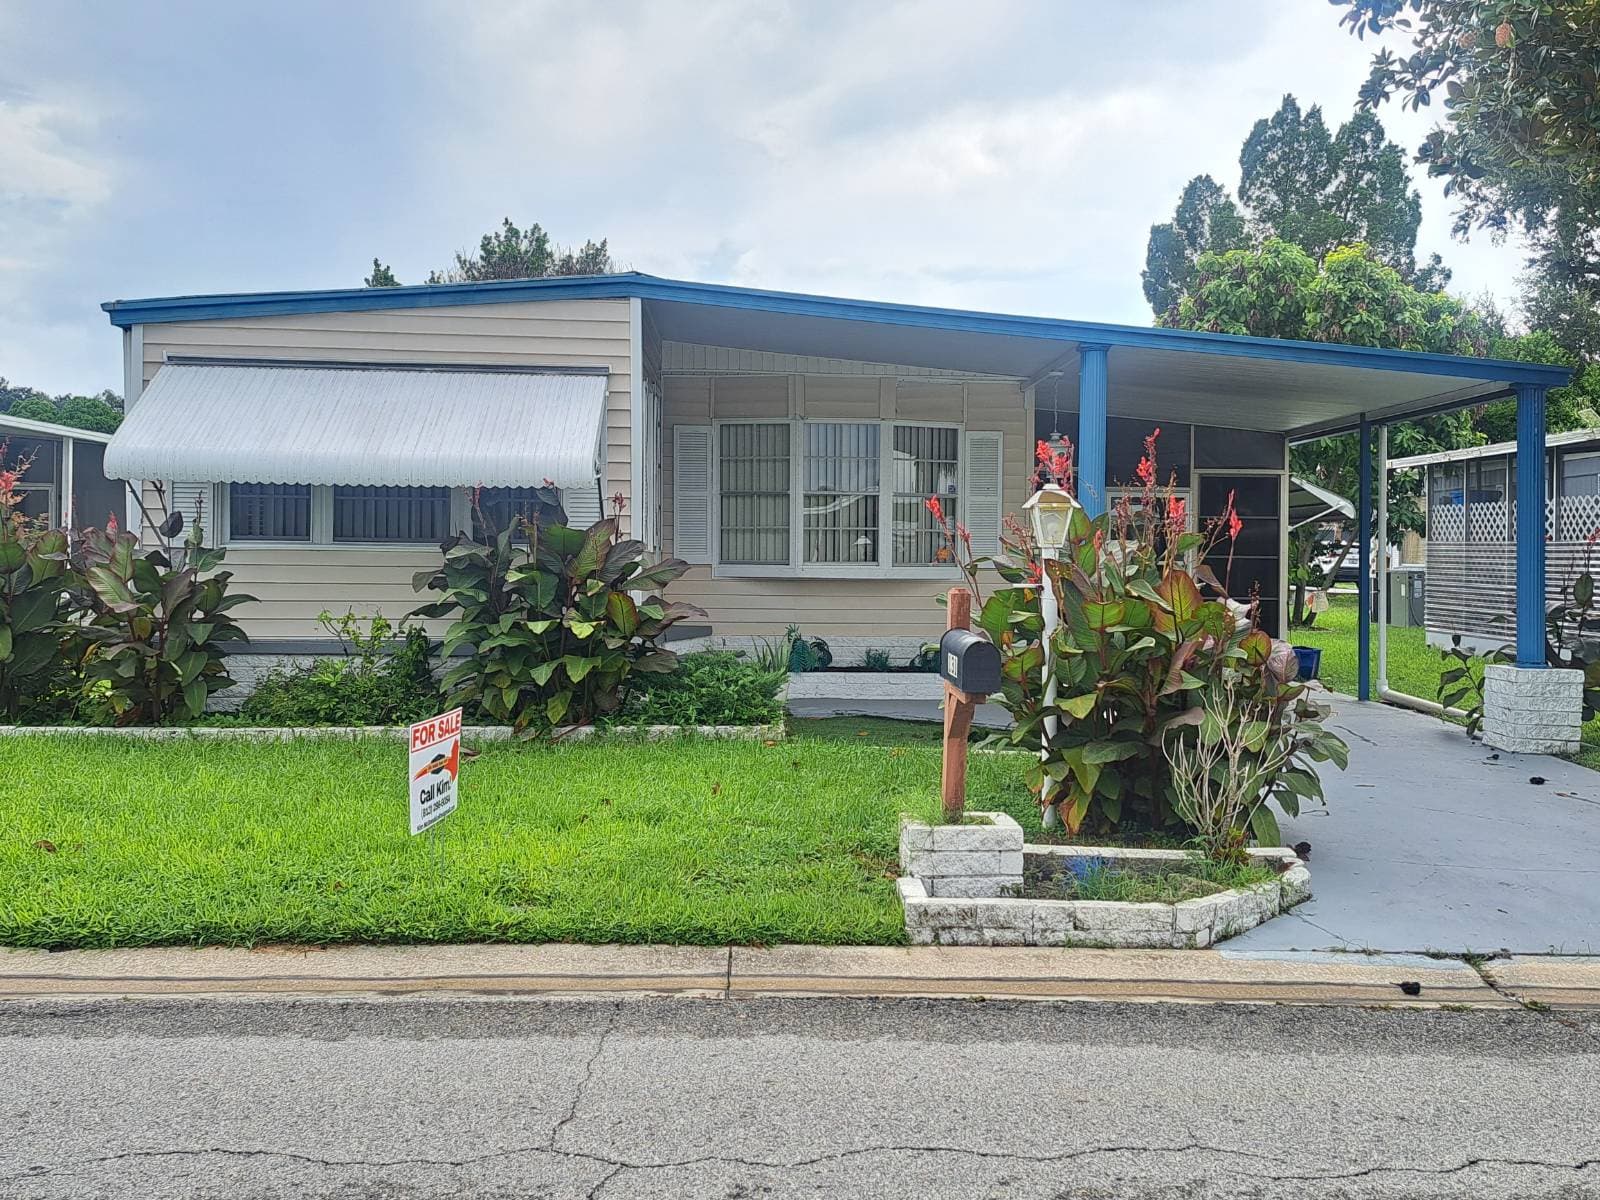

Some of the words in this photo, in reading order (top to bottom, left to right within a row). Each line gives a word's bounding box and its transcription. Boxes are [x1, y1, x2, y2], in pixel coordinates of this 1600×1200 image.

[413, 723, 435, 748] FOR
[438, 713, 460, 738] SALE
[420, 783, 435, 805] Call
